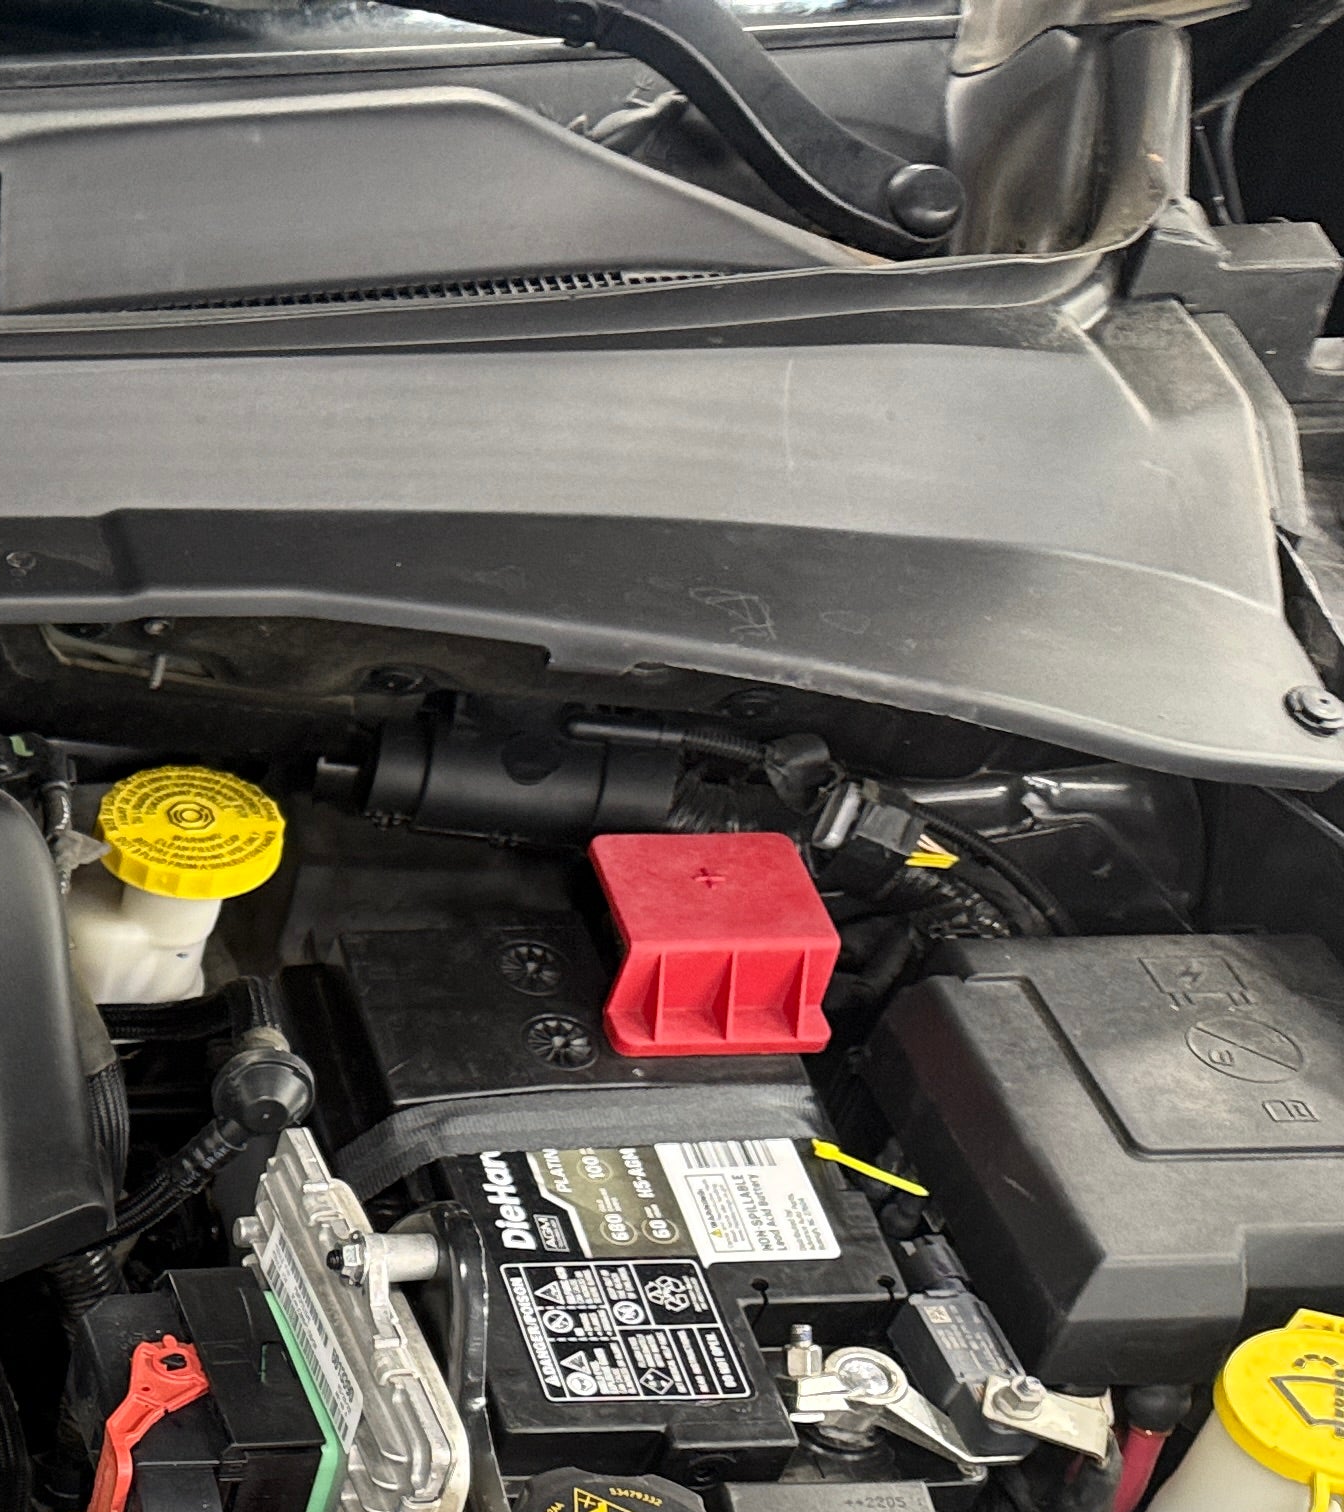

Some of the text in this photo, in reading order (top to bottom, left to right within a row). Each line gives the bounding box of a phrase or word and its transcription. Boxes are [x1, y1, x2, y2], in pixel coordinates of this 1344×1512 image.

[581, 1155, 606, 1179] 100
[731, 1174, 775, 1252] NON-SPILLABLE
[604, 1213, 630, 1241] 680
[648, 1219, 671, 1239] 60
[769, 1229, 788, 1251] Lead
[509, 1276, 558, 1377] DANGER/POISON
